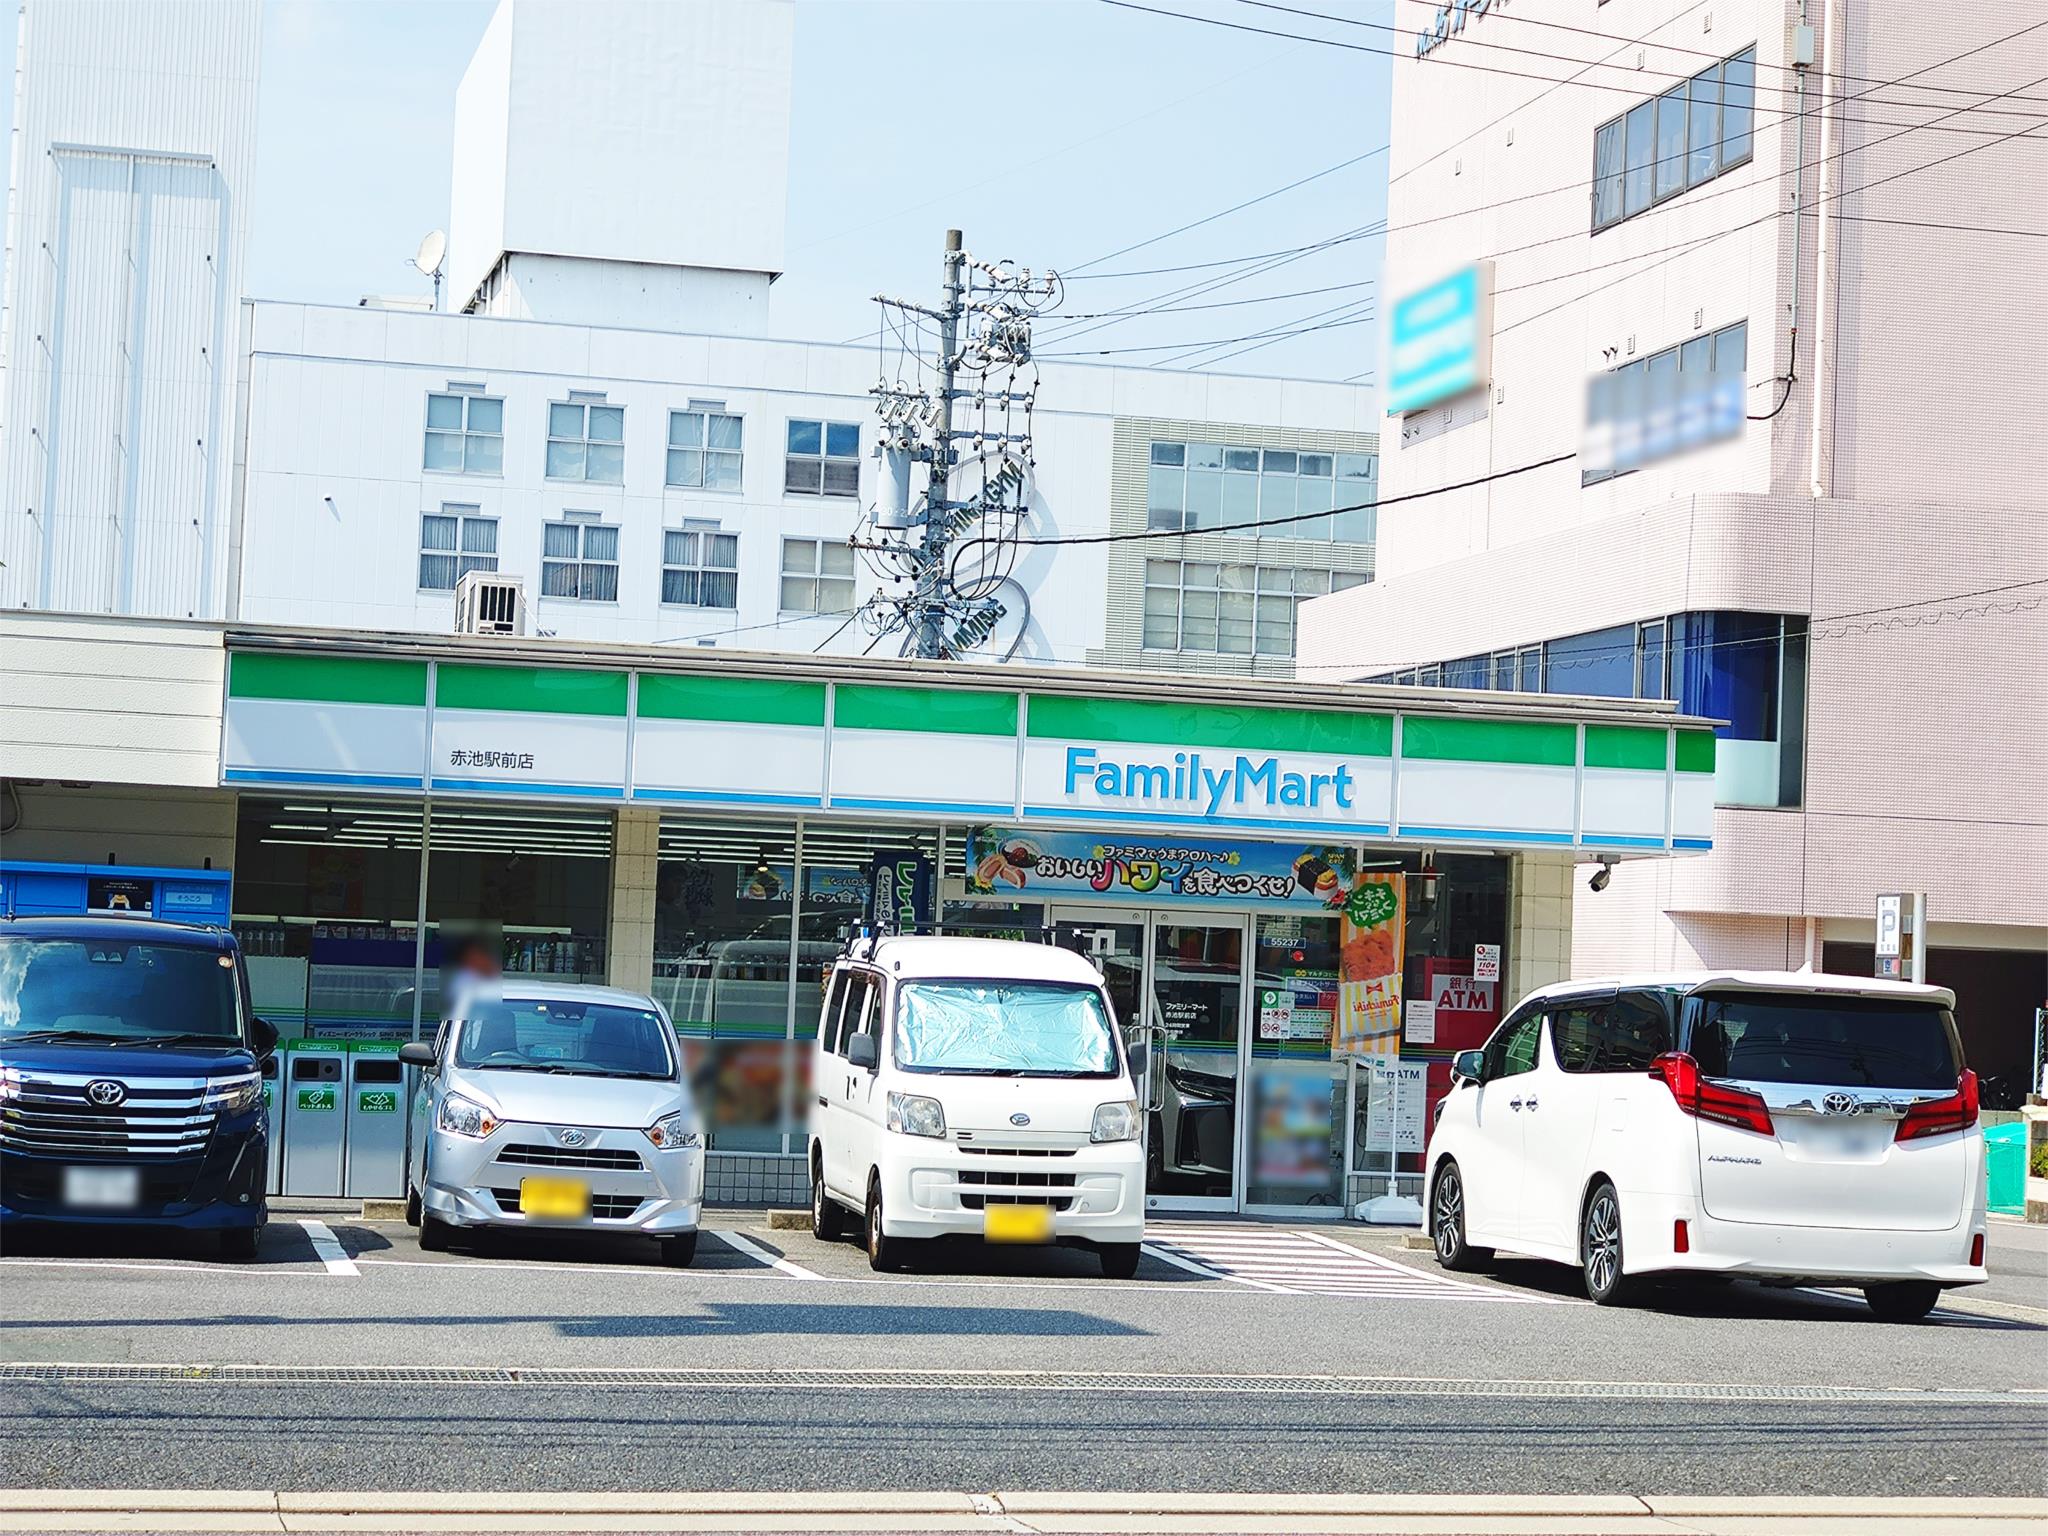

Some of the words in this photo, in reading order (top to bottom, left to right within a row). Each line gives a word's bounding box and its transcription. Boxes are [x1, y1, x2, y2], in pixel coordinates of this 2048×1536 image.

[984, 461, 1025, 504] GYM
[450, 749, 534, 769] 赤池駅前店
[1065, 746, 1353, 816] FamilyMart
[1882, 910, 1896, 942] P
[1271, 937, 1299, 947] 55237
[1450, 976, 1477, 990] 銀行
[1166, 1002, 1208, 1011] ファミリーマート
[1437, 990, 1488, 1010] ATM
